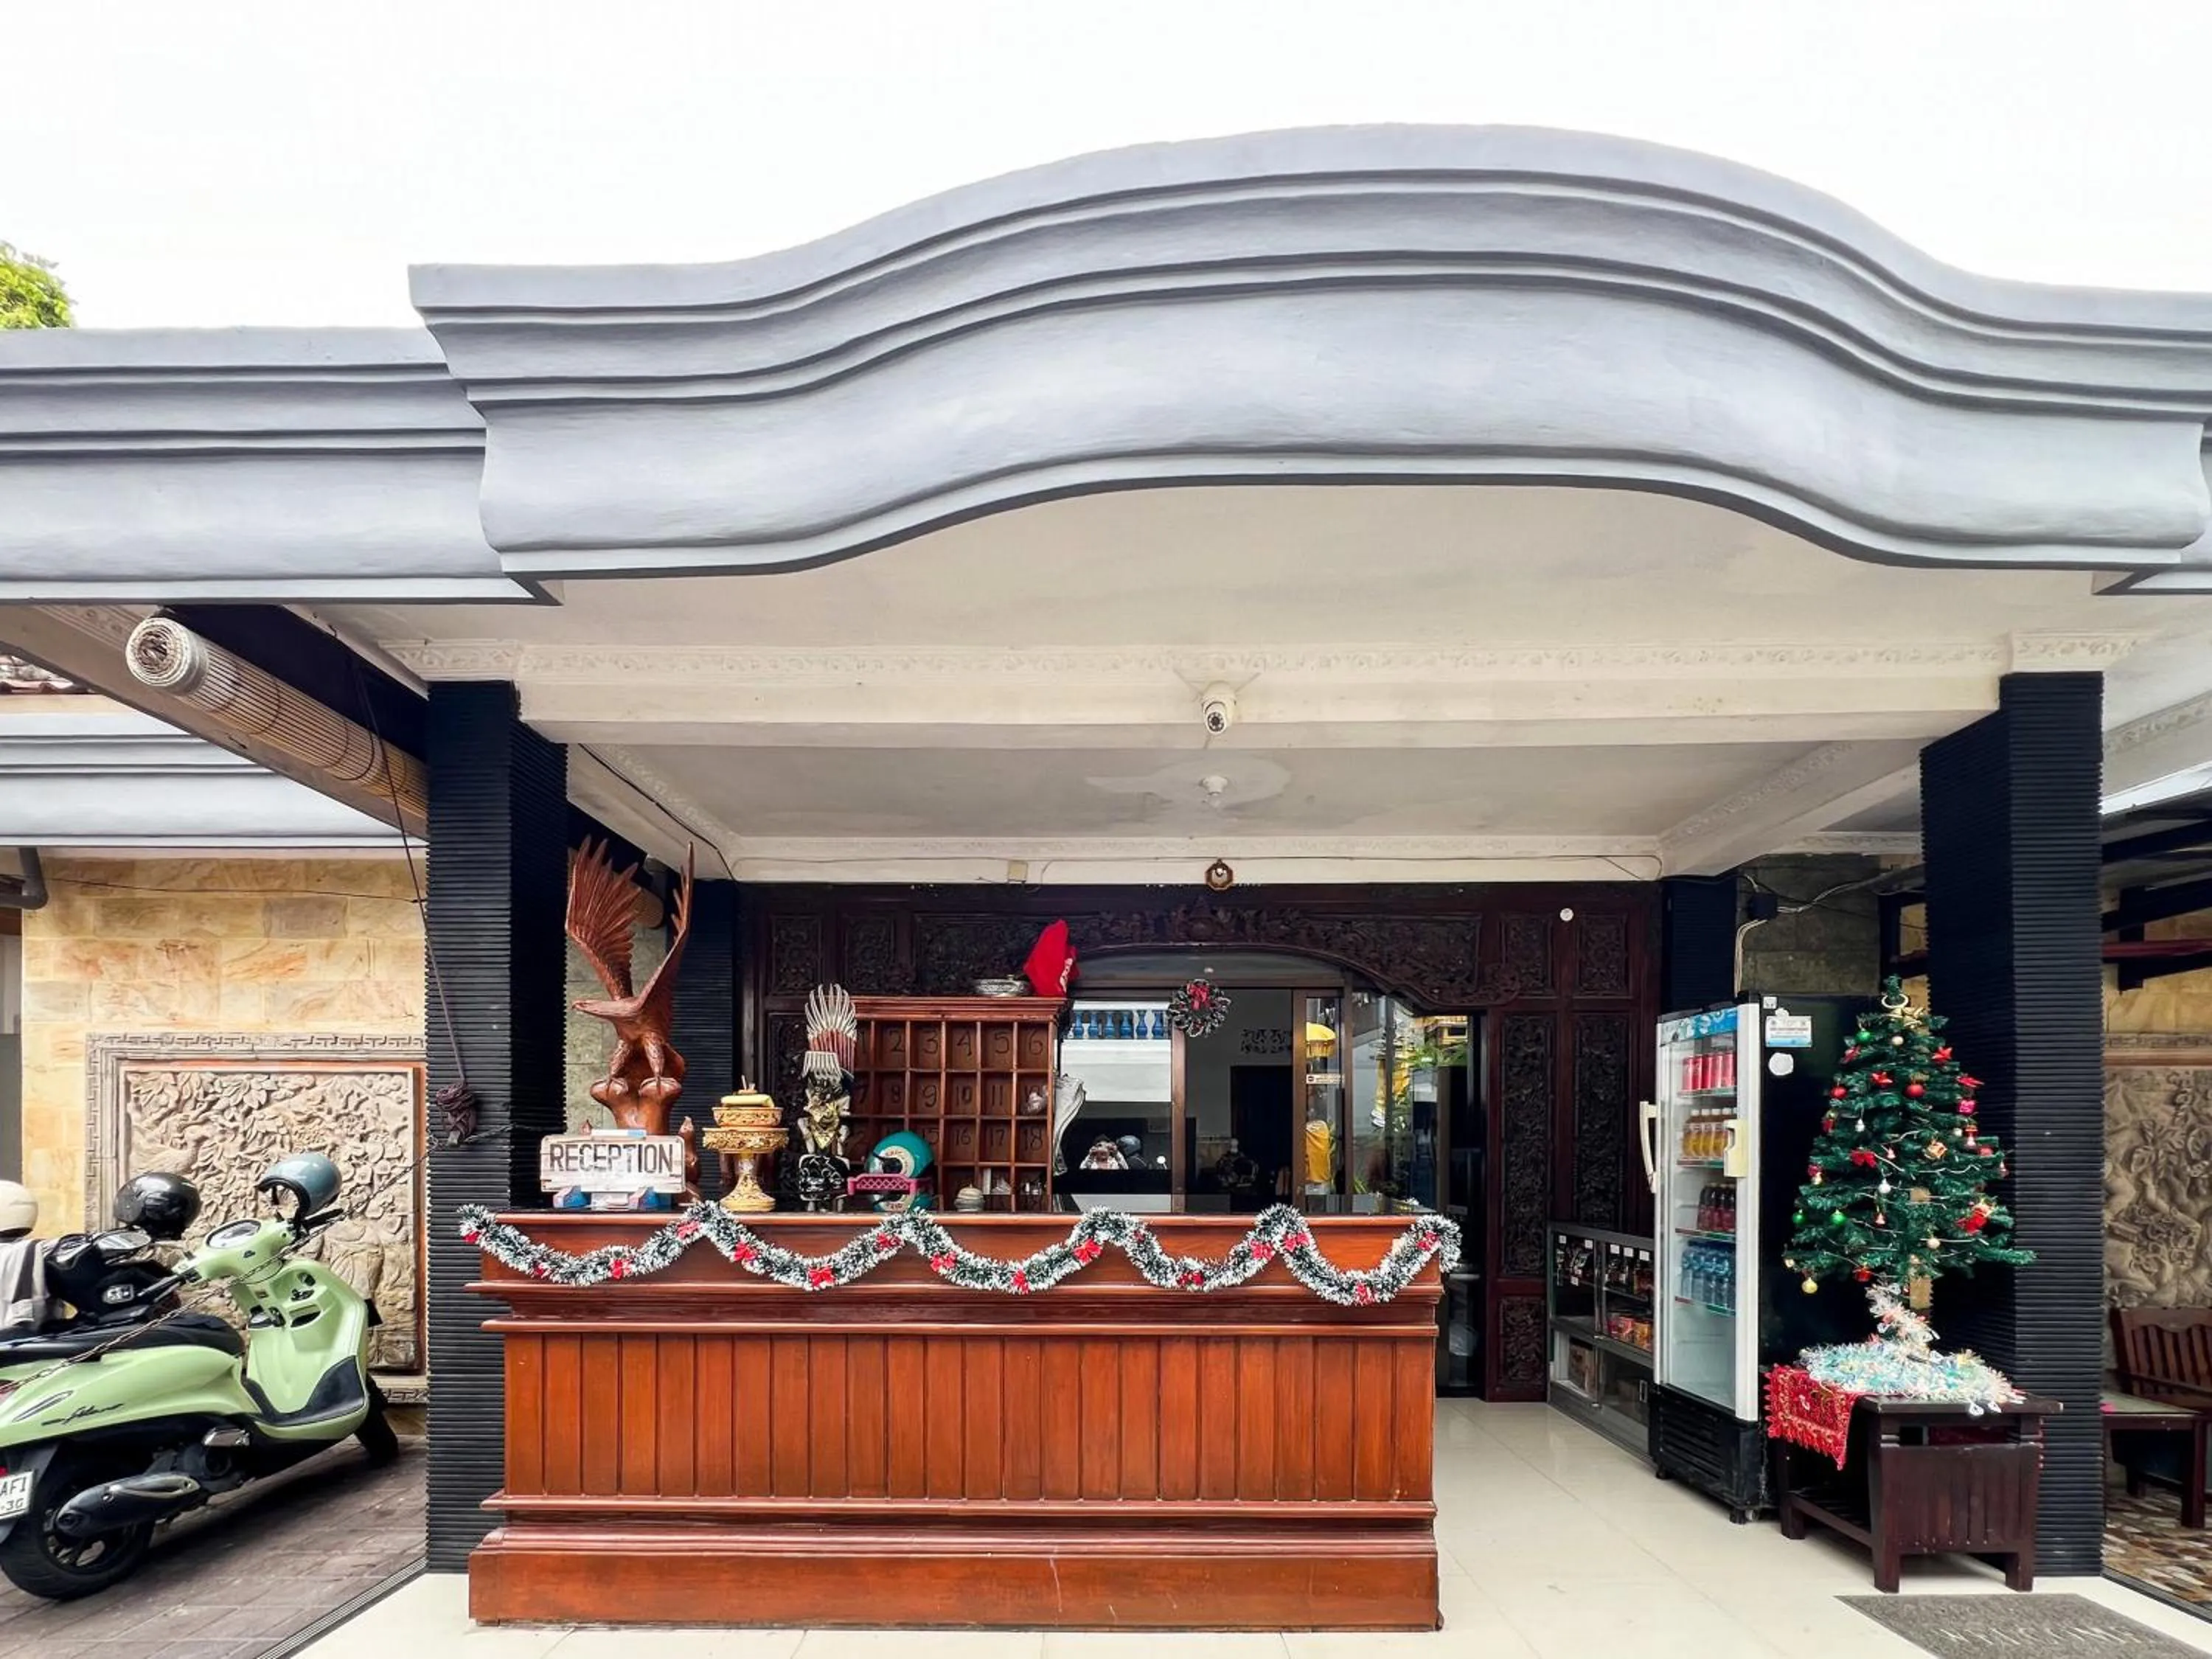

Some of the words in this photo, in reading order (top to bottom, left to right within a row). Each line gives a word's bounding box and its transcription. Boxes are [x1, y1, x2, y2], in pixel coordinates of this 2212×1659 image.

[889, 1029, 905, 1052] 2
[923, 1030, 939, 1054] 3
[956, 1030, 972, 1056] 4
[995, 1032, 1011, 1054] 5
[1029, 1030, 1043, 1055] 6
[891, 1084, 901, 1104] 8
[922, 1084, 937, 1107] 9
[956, 1085, 973, 1106] 10
[991, 1084, 1004, 1106] 11
[954, 1127, 971, 1145] 16
[990, 1128, 1005, 1147] 17
[1023, 1127, 1043, 1150] 18
[549, 1144, 672, 1173] RECEPTION
